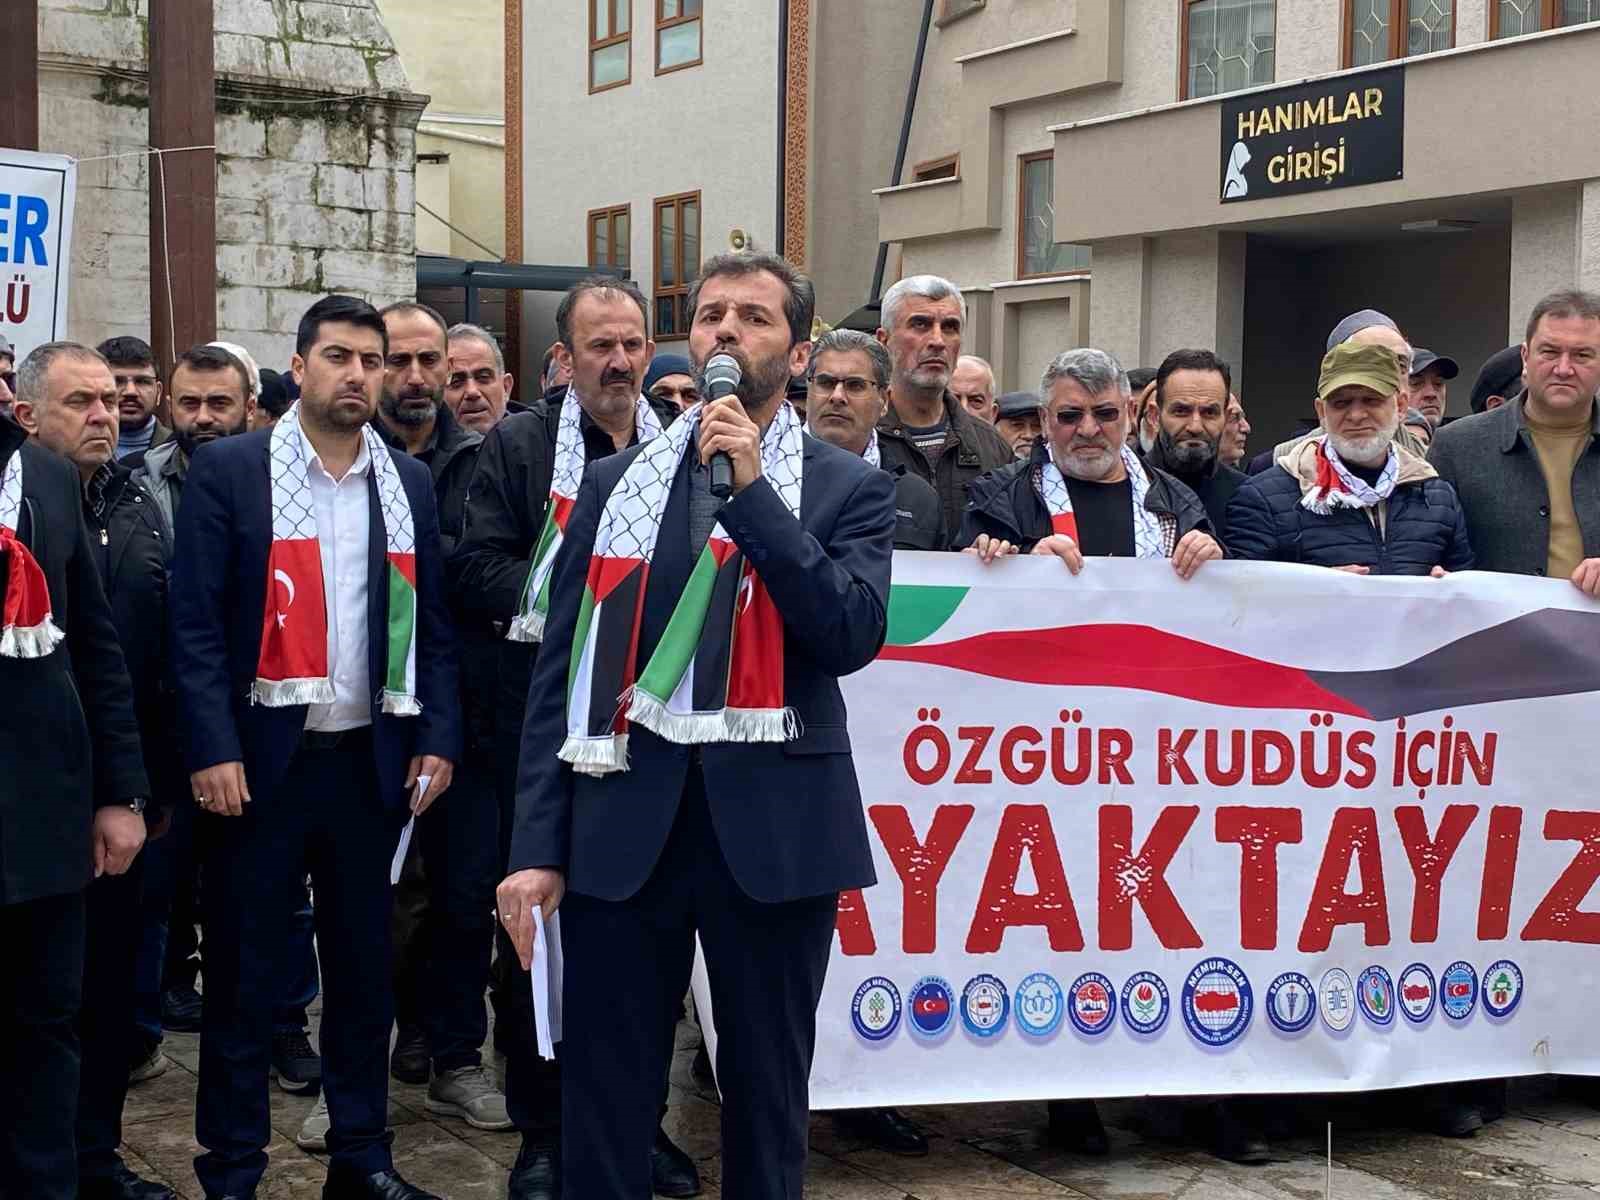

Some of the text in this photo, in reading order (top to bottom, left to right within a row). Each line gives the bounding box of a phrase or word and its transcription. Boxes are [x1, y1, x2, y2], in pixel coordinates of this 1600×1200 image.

[1238, 87, 1383, 139] HANIMLAR
[1267, 137, 1345, 184] GİRİŞİ
[903, 707, 1498, 800] ÖZGÜR KUDÜS İÇİN
[1188, 961, 1246, 987] MEMUR-SEN
